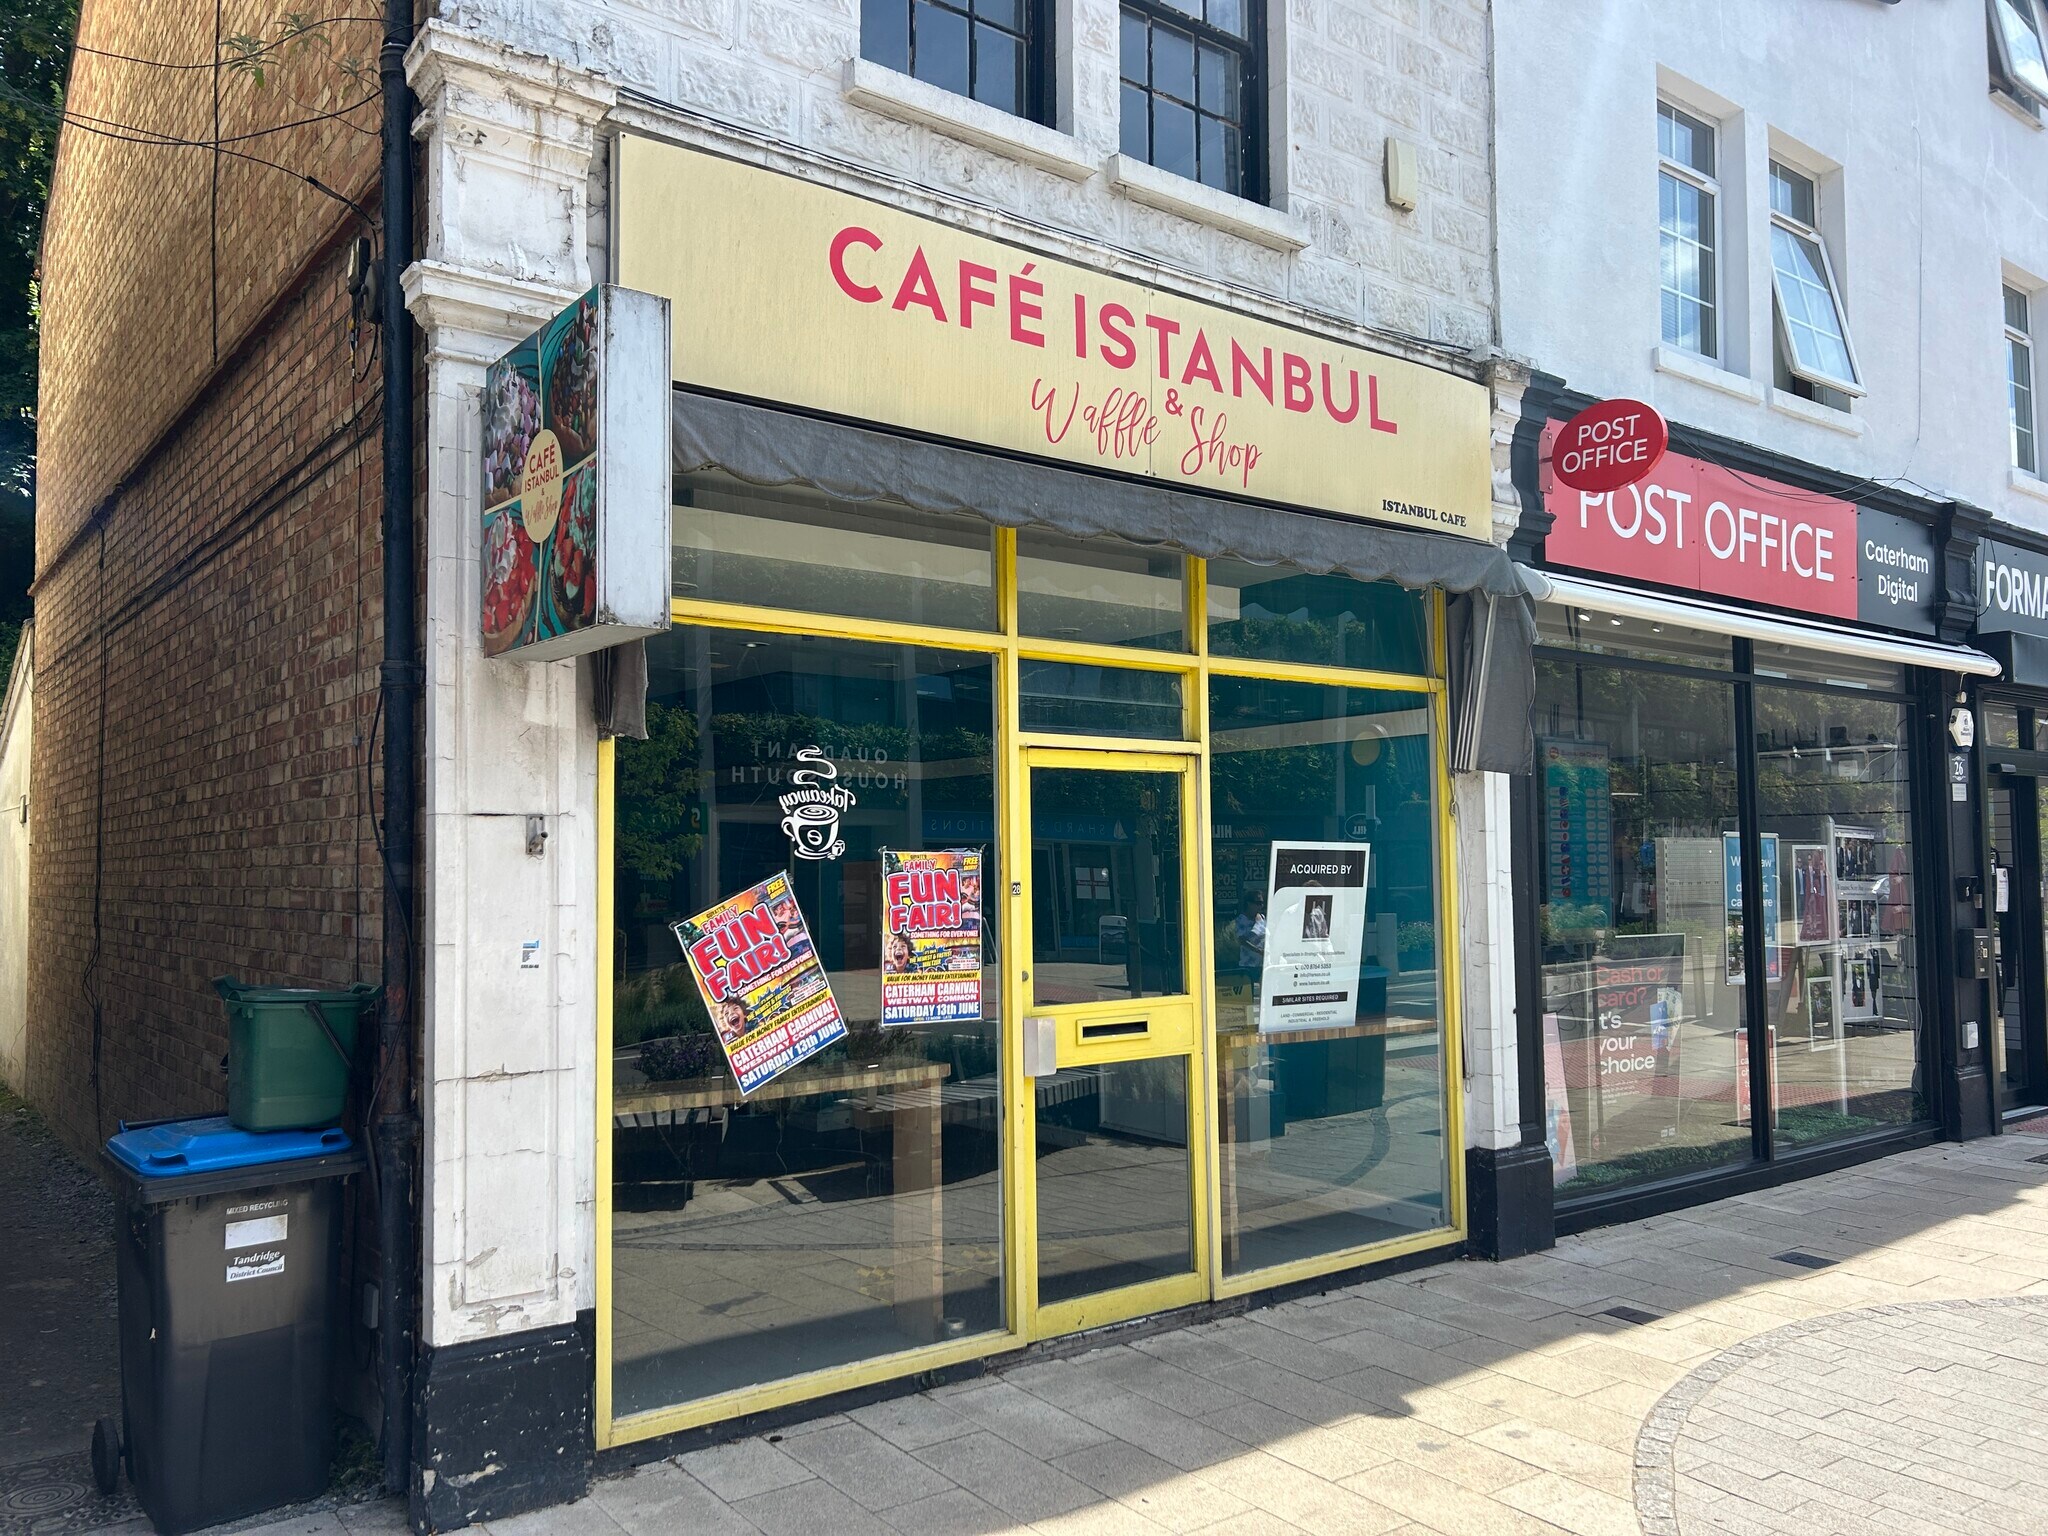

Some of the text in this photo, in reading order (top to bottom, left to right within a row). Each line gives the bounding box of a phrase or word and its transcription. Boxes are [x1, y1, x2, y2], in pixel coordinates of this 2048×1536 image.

[829, 226, 1398, 434] CAFÉ ISTANBUL
[1164, 387, 1184, 416] &
[1031, 378, 1263, 488] Waffle Shop
[1578, 414, 1641, 446] POST
[529, 439, 556, 474] CAFÉ
[1562, 438, 1648, 473] OFFICE
[525, 465, 559, 492] ISTANBUL
[1382, 499, 1467, 527] ISTANBUL CAFE
[1580, 483, 1835, 582] POST OFFICE
[1865, 540, 1929, 574] Caterham
[1878, 574, 1918, 605] Digital
[1954, 761, 1964, 775] 26
[903, 858, 937, 871] FAMILY
[963, 857, 978, 865] FREE
[1290, 864, 1339, 875] ACQUIRED
[1340, 864, 1352, 875] BY
[767, 877, 785, 893] FREE
[888, 871, 960, 906] FUN
[1012, 884, 1020, 894] 28
[701, 905, 739, 935] FAMILY
[891, 903, 962, 932] FAIR!
[690, 903, 777, 976] FUN
[705, 936, 790, 1001] FAIR!
[737, 974, 773, 996] SOMETHING
[771, 967, 785, 979] FOR
[1597, 965, 1664, 985] Cash or
[885, 981, 979, 998] CATERHAM CARNIVAL
[887, 993, 977, 1005] WESTWAY COMMON
[1598, 987, 1647, 1008] card?
[730, 1039, 745, 1052] VALUE
[746, 1033, 756, 1044] FOR
[757, 1023, 774, 1038] MONEY
[774, 1014, 791, 1029] FAMILY
[791, 991, 828, 1018] ENTERTAINMENT
[885, 1001, 979, 1019] SATURDAY 13th JUNE
[1599, 1011, 1622, 1030] t's
[732, 999, 835, 1068] CATERHAM CARNIVAL
[740, 1013, 836, 1073] WESTWAY COMMON
[1600, 1035, 1637, 1055] your
[740, 1019, 842, 1087] SATURDAY 13th JUNE
[1600, 1053, 1655, 1075] choice
[226, 1205, 248, 1215] MIXED
[230, 1263, 283, 1279] District Council
[233, 1250, 280, 1265] Tandridge
